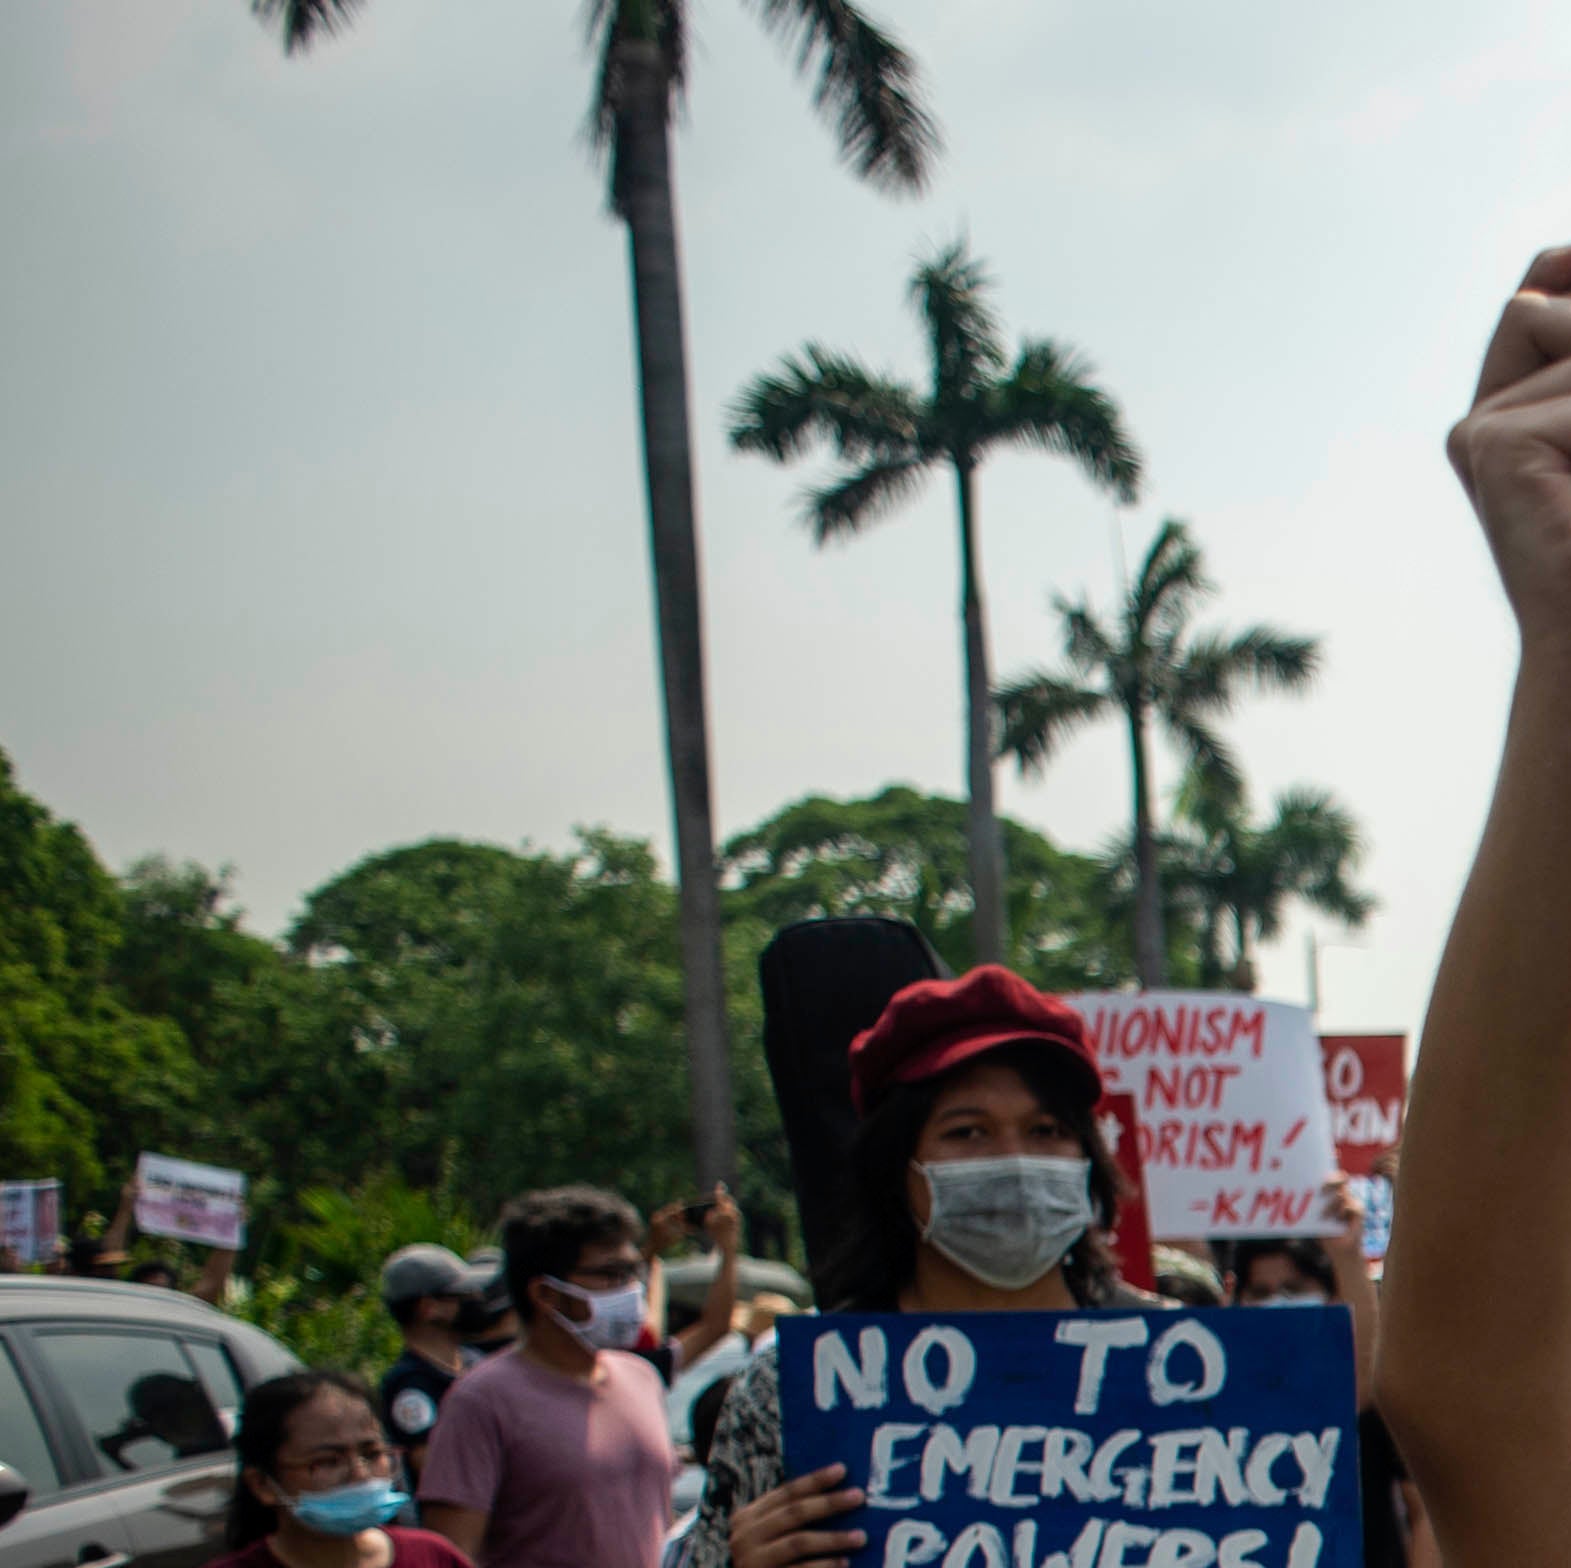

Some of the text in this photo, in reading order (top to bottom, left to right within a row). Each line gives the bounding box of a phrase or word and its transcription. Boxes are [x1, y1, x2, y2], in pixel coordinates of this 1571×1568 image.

[1143, 1063, 1242, 1111] NOT
[813, 1315, 1227, 1415] NO TO
[866, 1421, 1342, 1509] EMERGENCY
